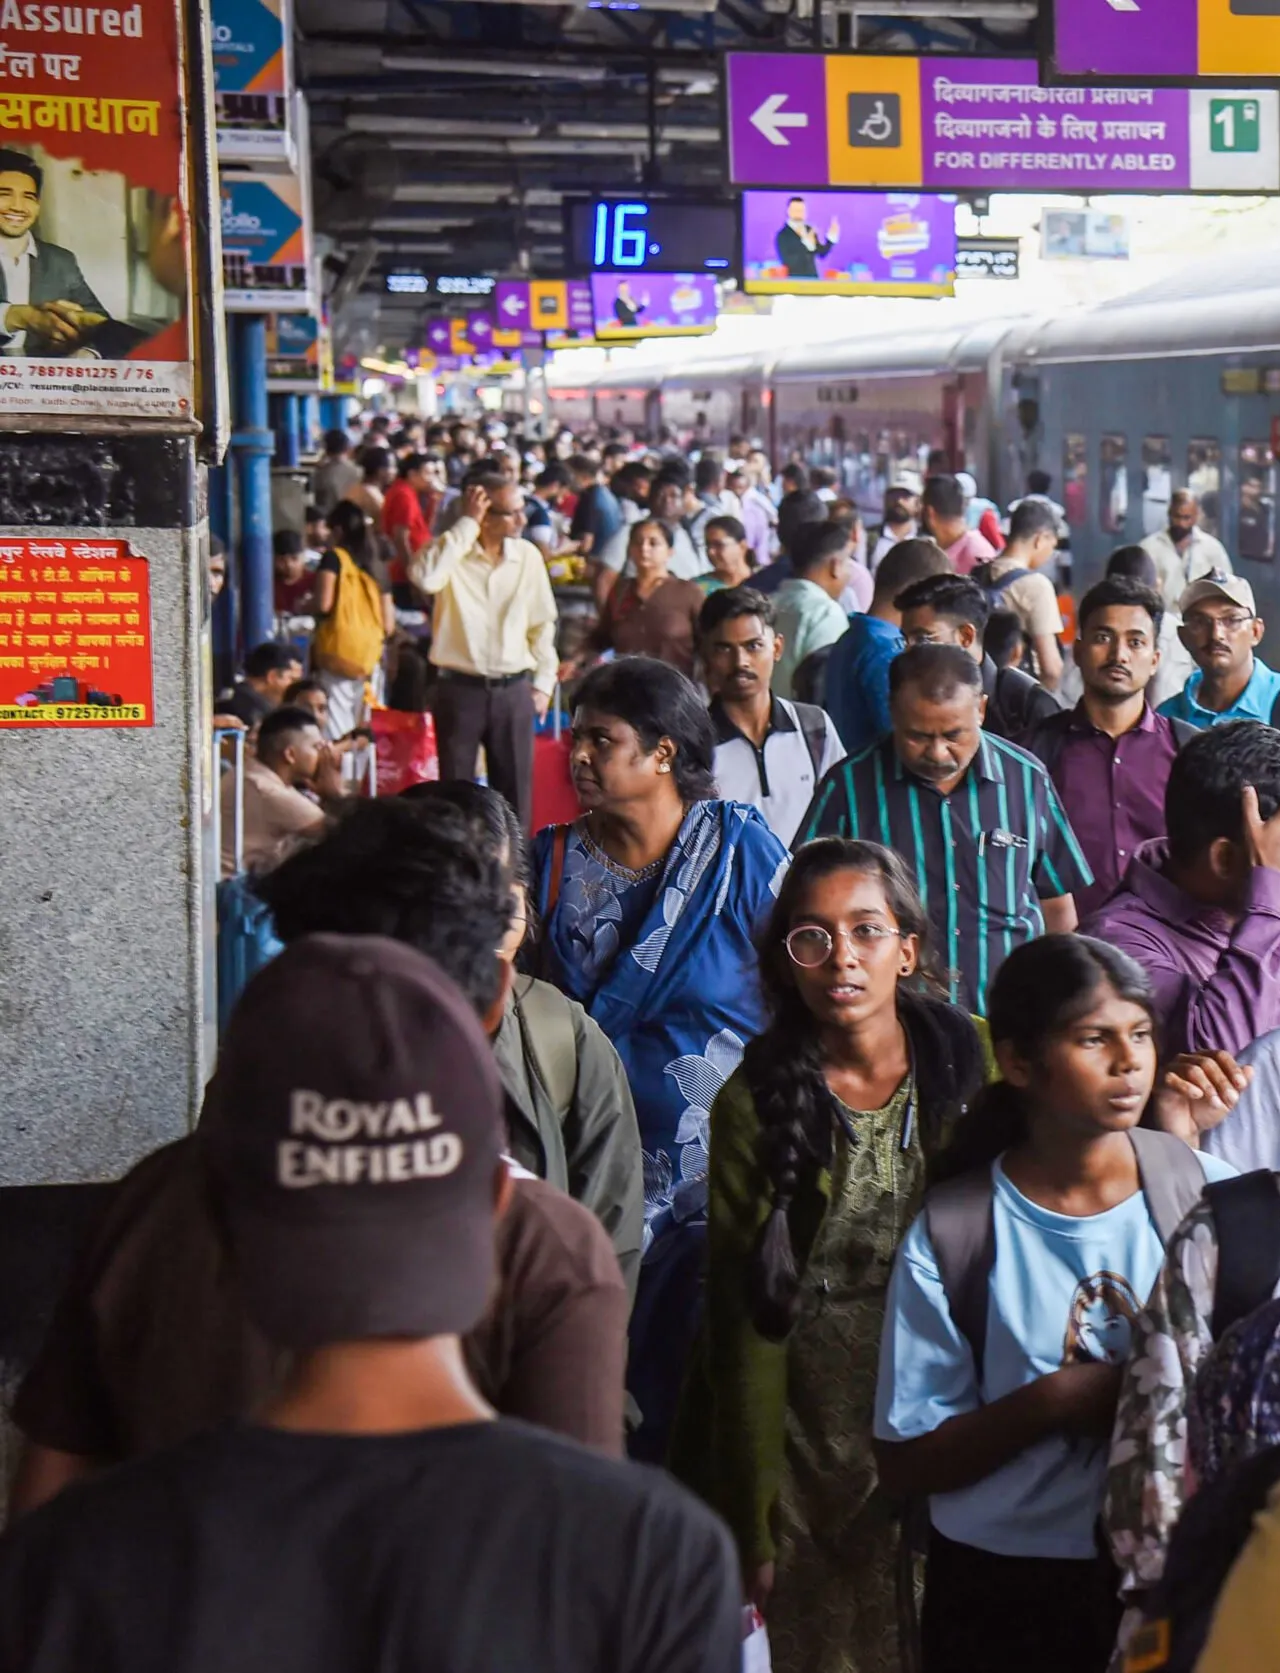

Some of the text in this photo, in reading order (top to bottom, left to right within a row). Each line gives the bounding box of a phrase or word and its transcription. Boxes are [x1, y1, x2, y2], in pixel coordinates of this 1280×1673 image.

[1, 0, 144, 37] Assured
[41, 53, 82, 80] पर
[1036, 114, 1056, 138] के
[1061, 113, 1097, 143] लिए
[1214, 105, 1235, 148] 1
[934, 152, 1176, 171] FOR DIFFERENTLY ABLED
[28, 365, 118, 379] 7887881275
[136, 368, 154, 380] 76
[28, 542, 67, 558] रेलवे
[71, 543, 118, 559] स्टेशन
[56, 707, 140, 719] 9725731176
[290, 1088, 443, 1142] ROYAL
[277, 1132, 463, 1189] ENFIELD
